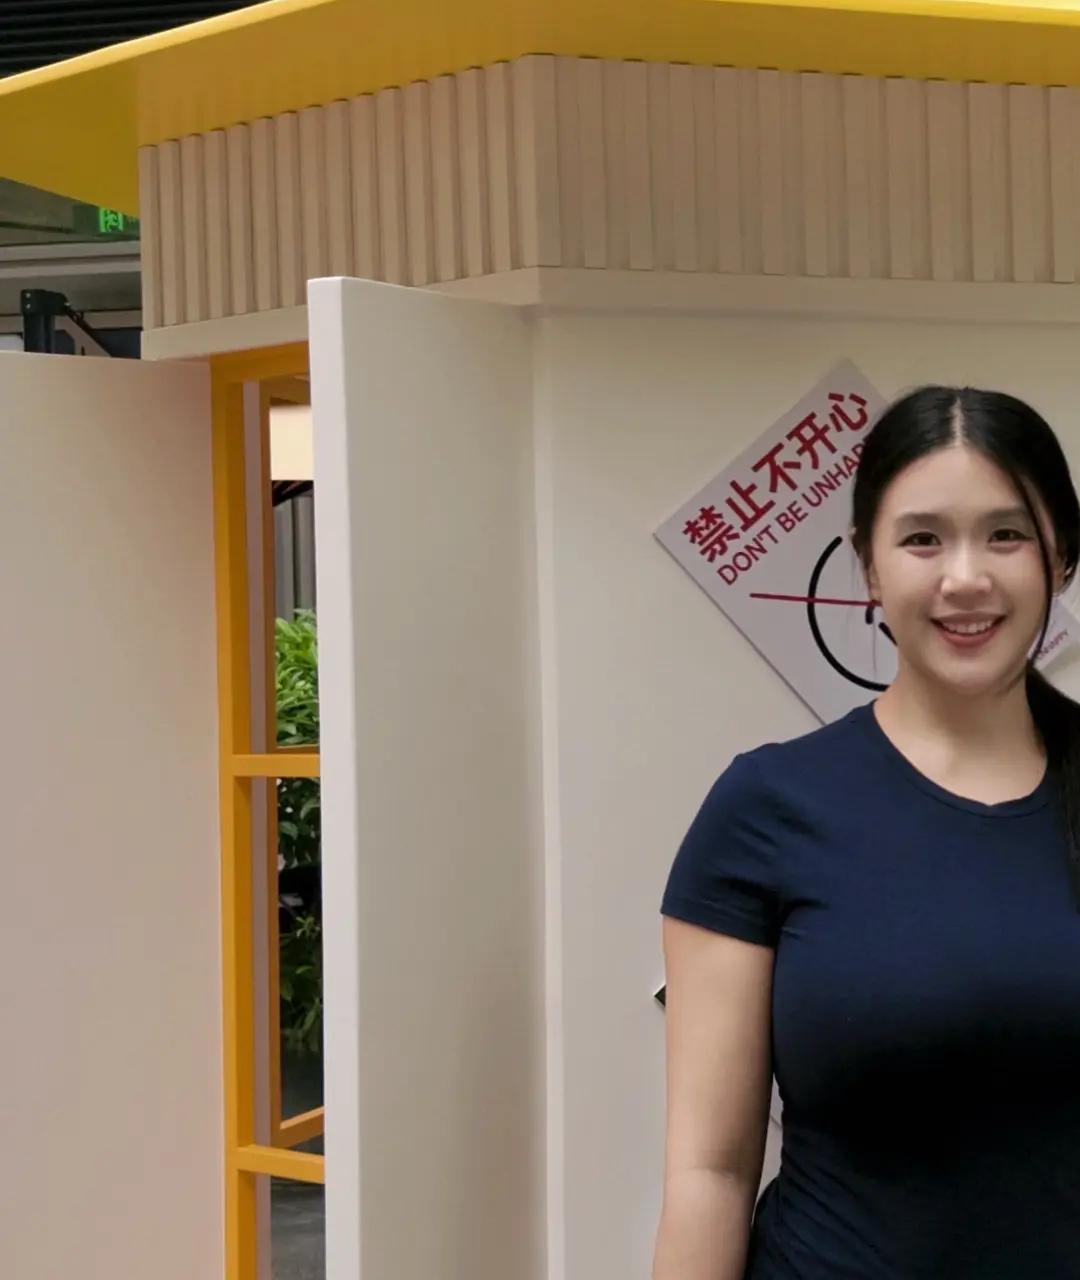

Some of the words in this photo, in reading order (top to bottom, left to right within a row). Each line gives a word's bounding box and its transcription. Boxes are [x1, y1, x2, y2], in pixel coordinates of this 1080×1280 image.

[682, 392, 869, 563] 禁止不开心
[716, 524, 779, 586] DON'T
[774, 500, 809, 533] BE
[801, 442, 866, 508] UNHAP
